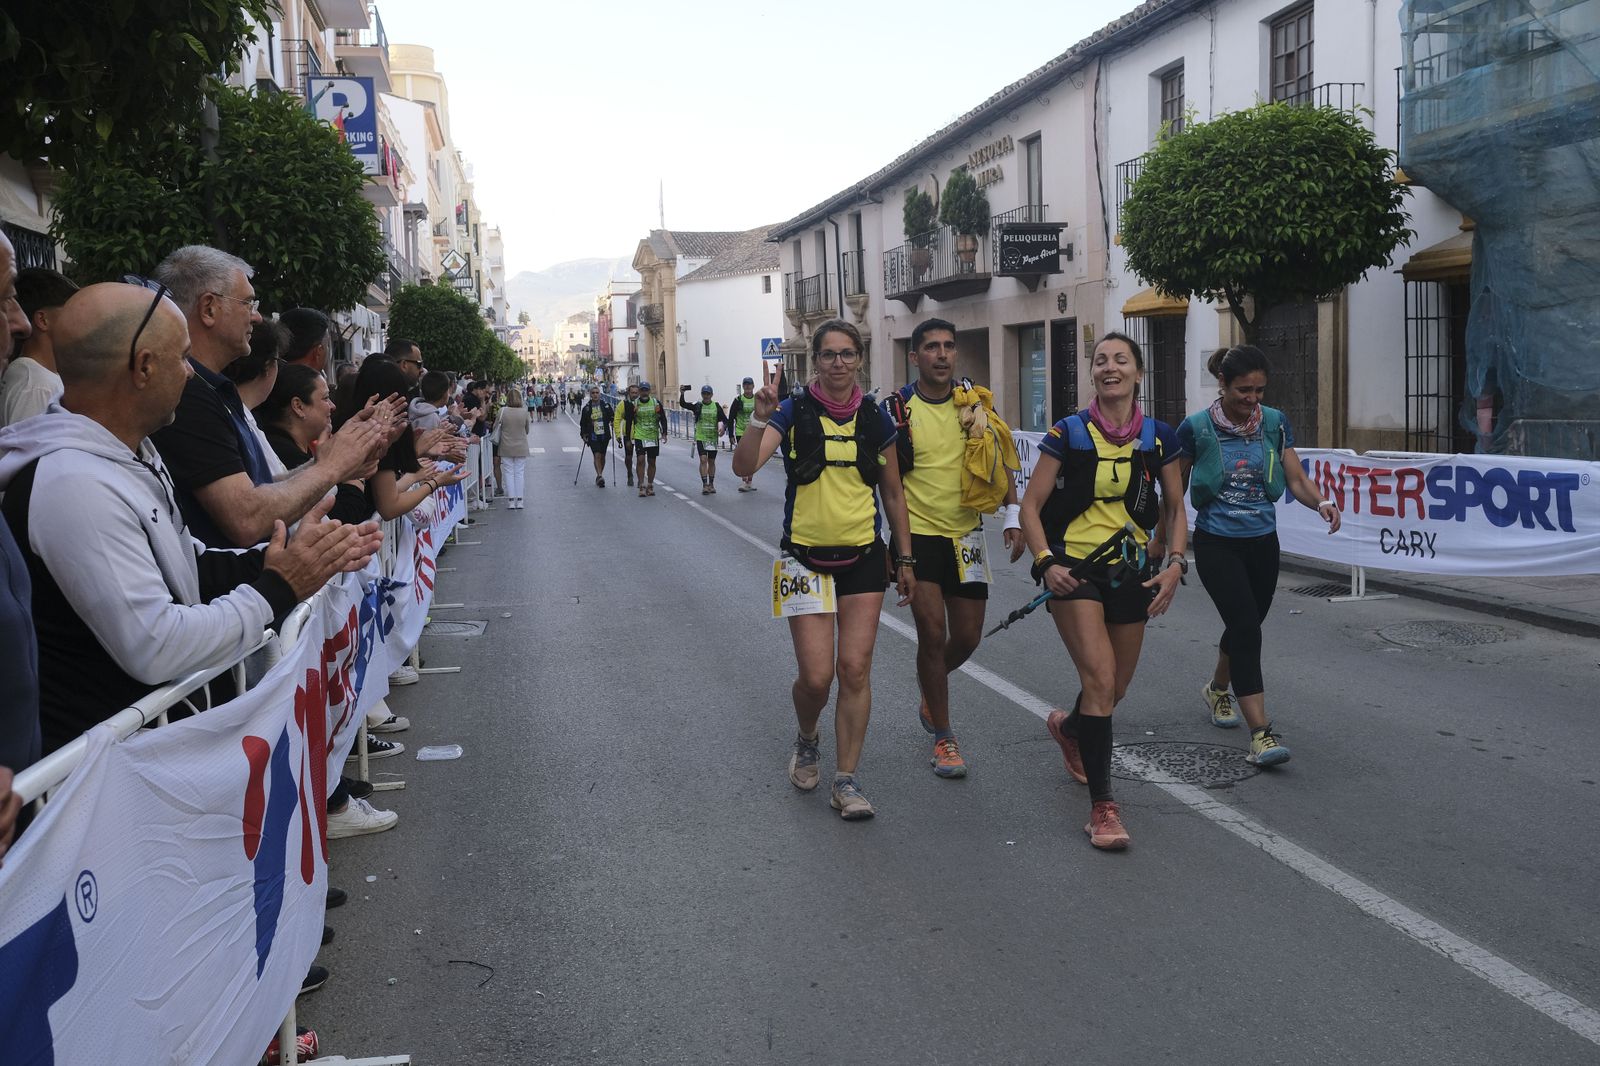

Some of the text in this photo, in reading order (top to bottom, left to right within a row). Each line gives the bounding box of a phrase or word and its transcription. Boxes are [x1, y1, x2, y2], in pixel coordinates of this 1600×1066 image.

[344, 131, 374, 143] RKING
[1003, 234, 1057, 244] PELUQUERIA
[1314, 460, 1579, 533] INTERSPORT
[1380, 528, 1437, 559] CARY
[961, 547, 985, 565] 648
[780, 575, 820, 597] 6481
